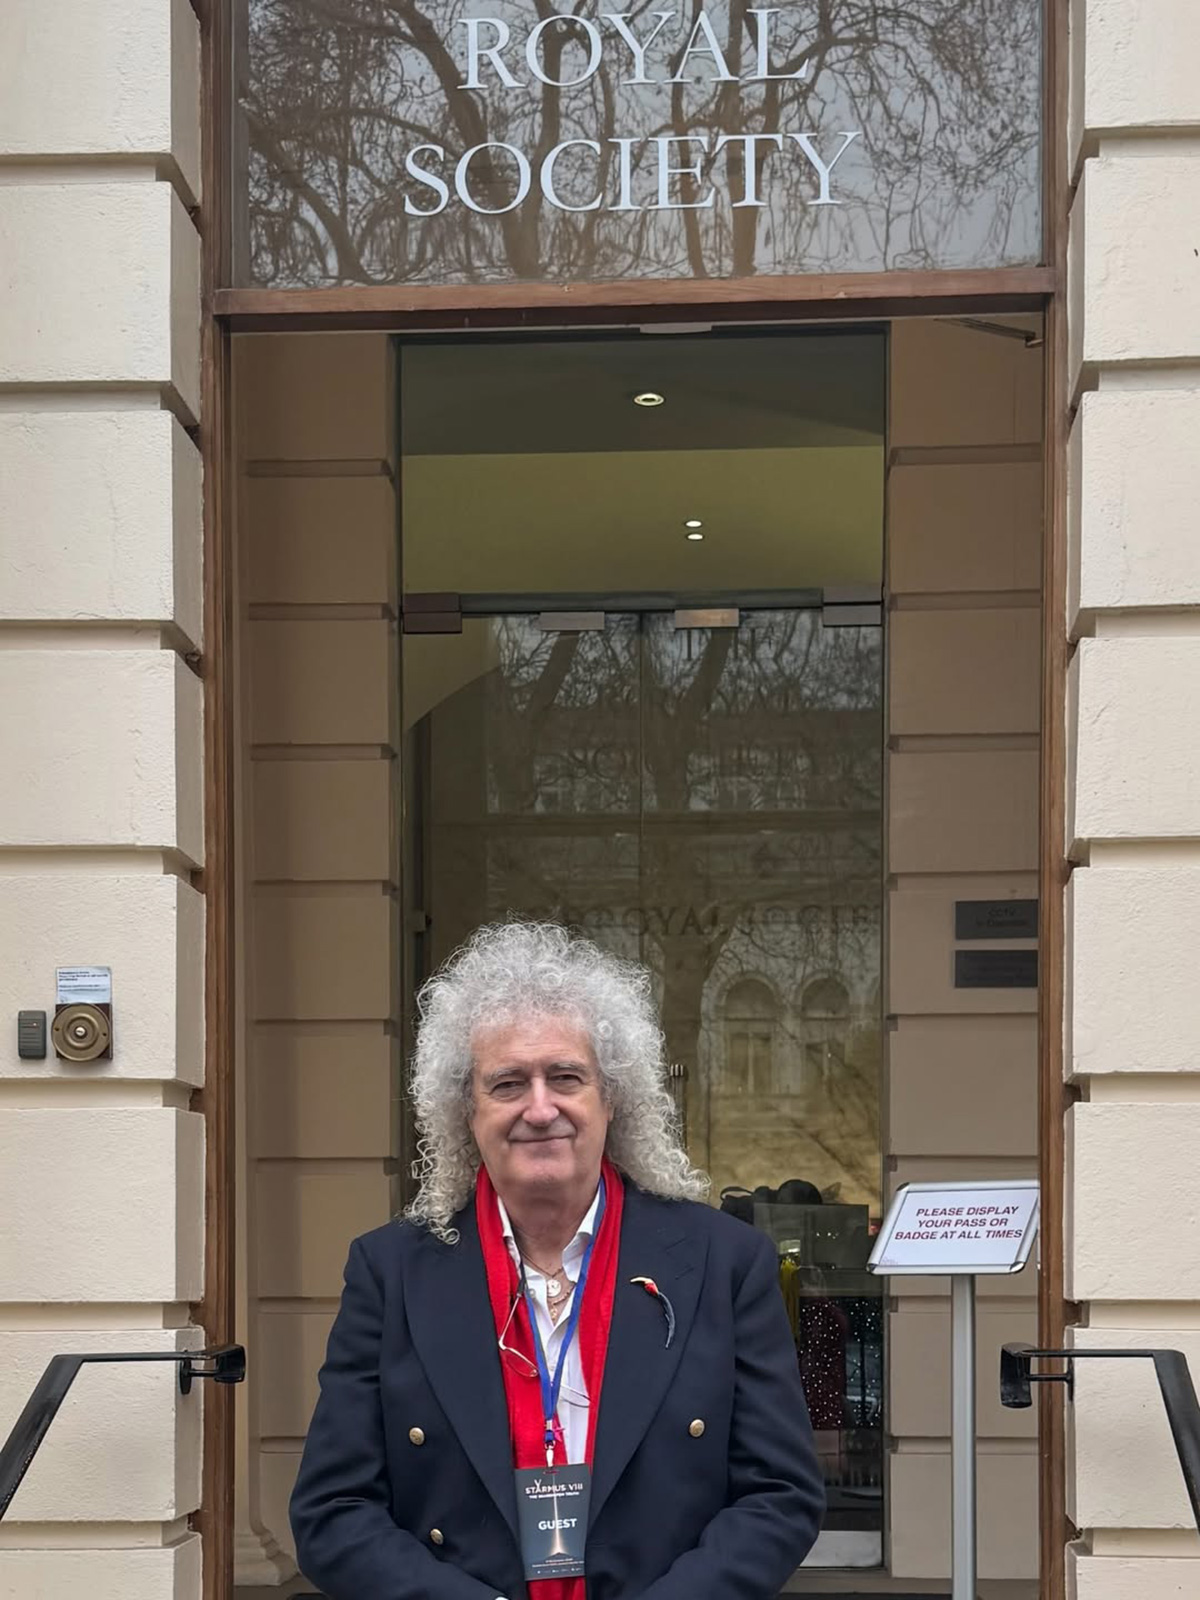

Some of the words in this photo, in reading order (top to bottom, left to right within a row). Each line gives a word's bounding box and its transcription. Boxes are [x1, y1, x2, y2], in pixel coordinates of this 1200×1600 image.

[456, 7, 810, 90] ROYAL
[403, 131, 862, 217] SOCIETY
[916, 1207, 965, 1216] PLEASE
[966, 1206, 1019, 1216] DISPLAY
[918, 1219, 952, 1228] YOUR
[954, 1218, 987, 1228] PASS
[990, 1217, 1008, 1227] OR
[894, 1230, 938, 1240] BADGE
[940, 1230, 957, 1239] AT
[957, 1229, 981, 1239] ALL
[986, 1229, 1023, 1239] TIMES
[525, 1479, 567, 1494] STARMUS
[538, 1518, 578, 1530] GUEST
